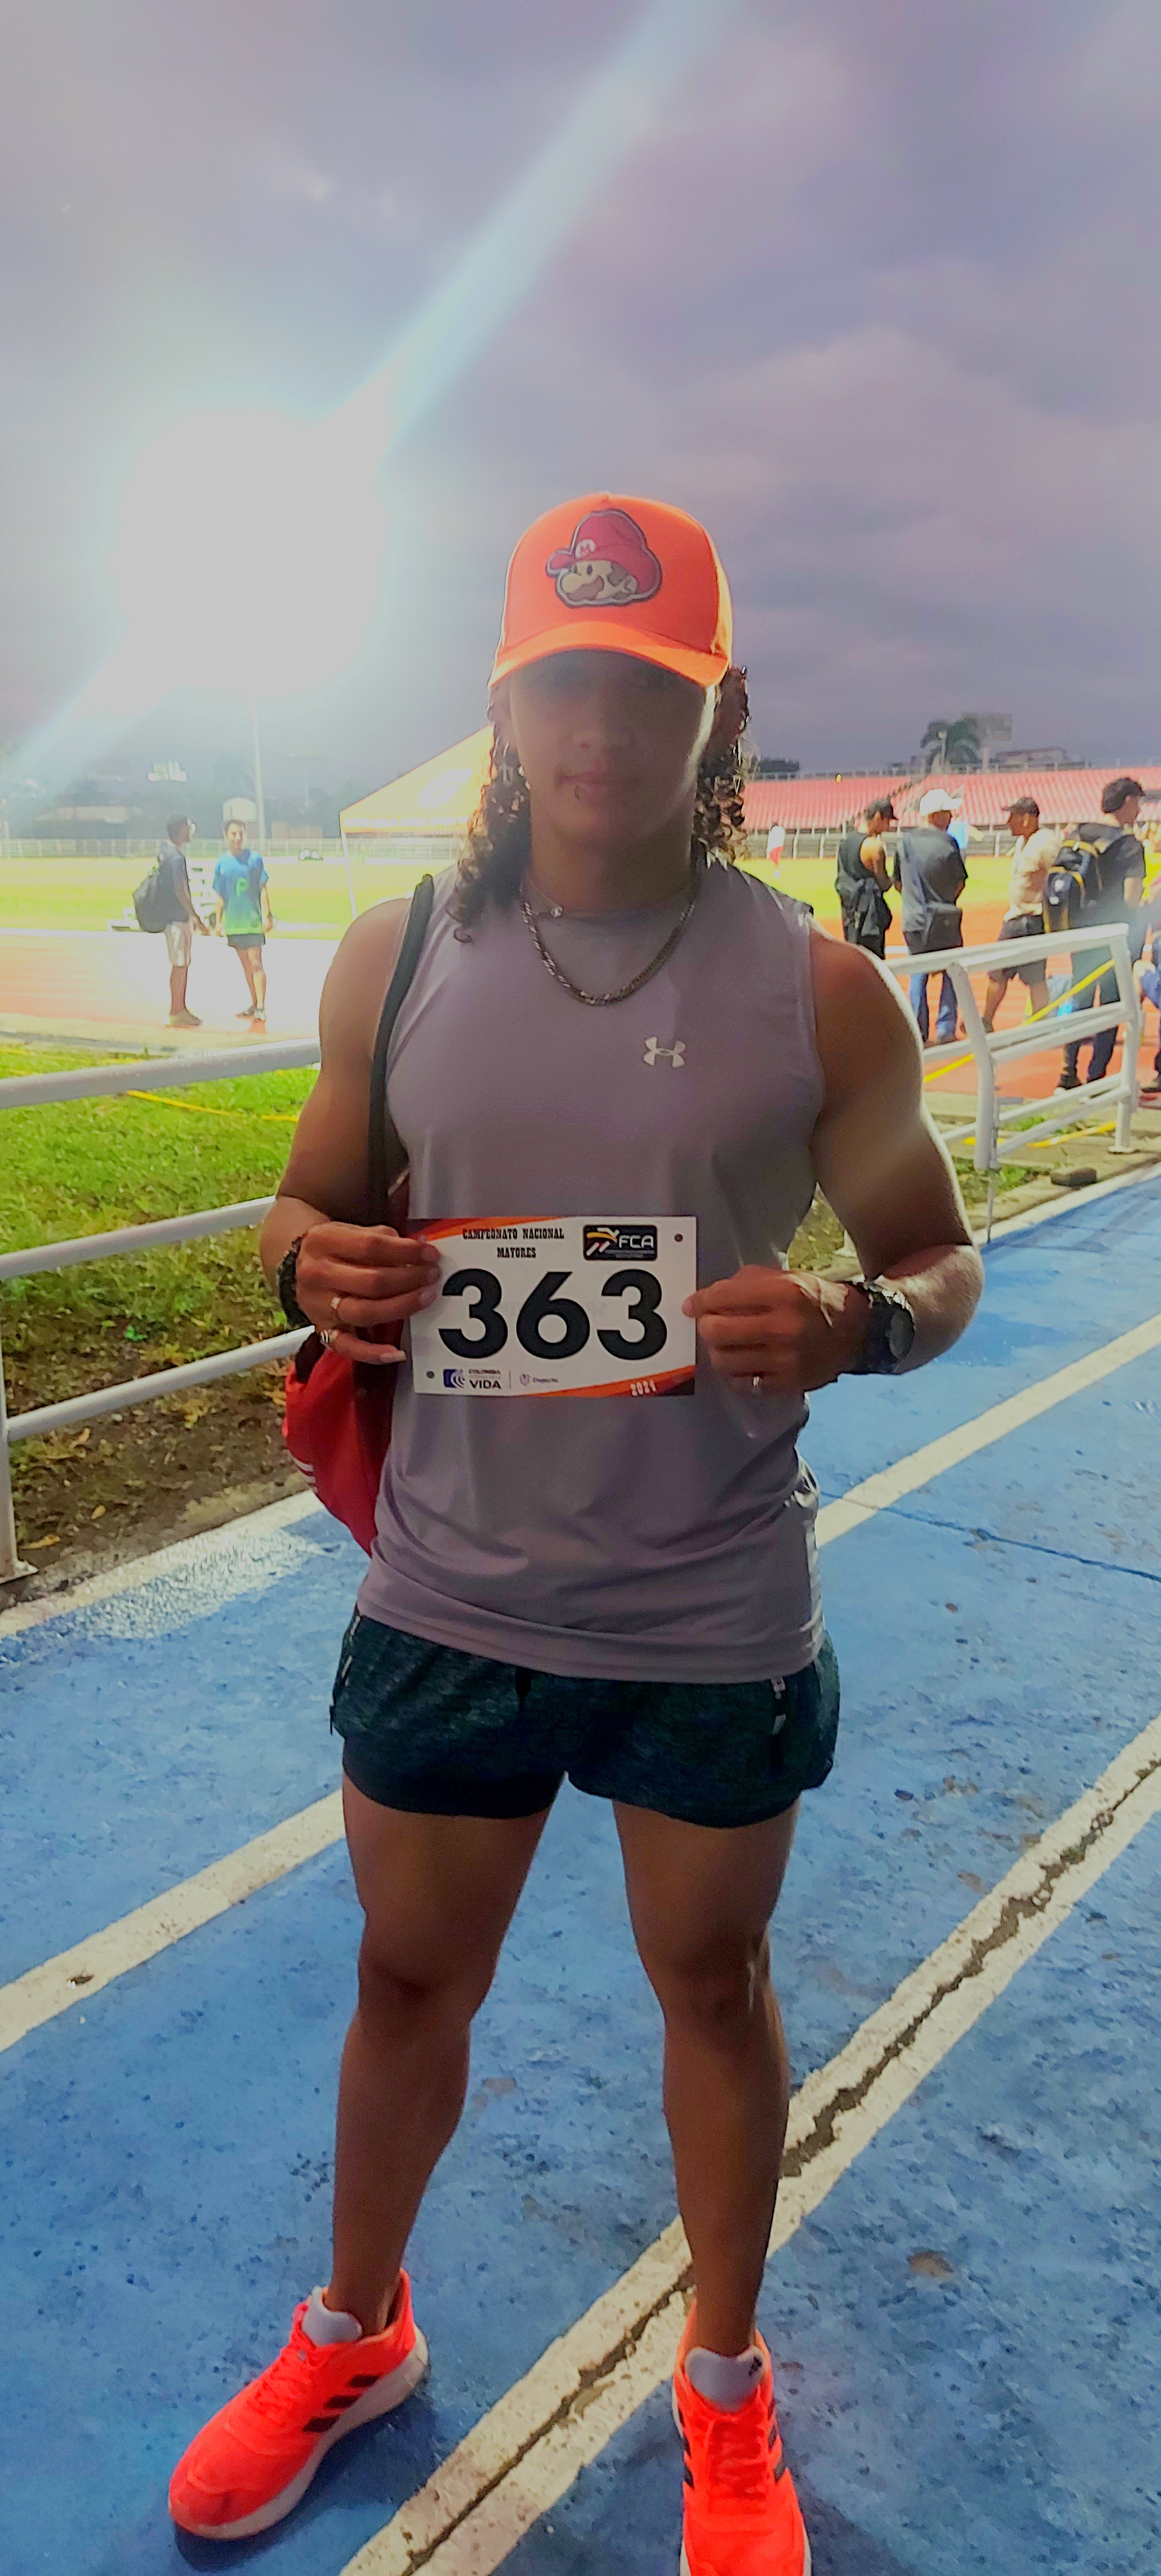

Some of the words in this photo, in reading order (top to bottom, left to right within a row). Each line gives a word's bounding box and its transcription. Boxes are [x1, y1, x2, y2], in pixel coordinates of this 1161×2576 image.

[462, 1228, 518, 1240] CAMPEONATO
[523, 1228, 564, 1239] NACIONAL
[619, 1235, 653, 1248] FCA
[497, 1247, 536, 1258] MAYORES
[438, 1269, 667, 1360] 363
[470, 1379, 501, 1389] VIDA
[630, 1379, 656, 1396] 2021
